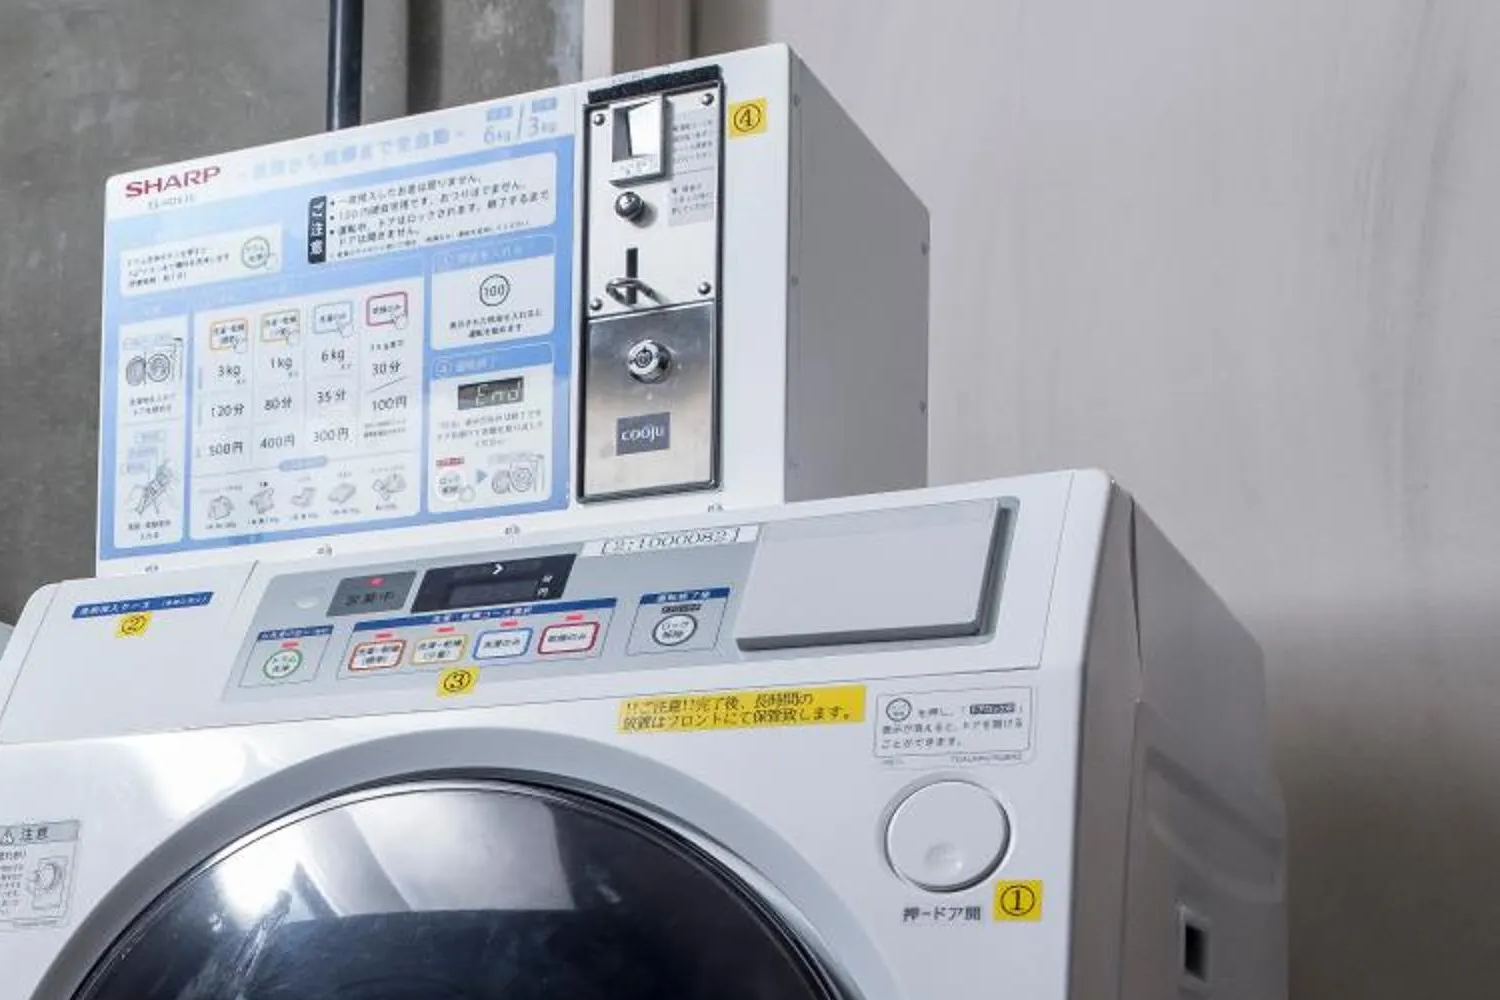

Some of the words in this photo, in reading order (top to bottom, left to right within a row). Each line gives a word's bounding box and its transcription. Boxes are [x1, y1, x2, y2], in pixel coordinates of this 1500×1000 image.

[125, 166, 221, 198] SHARP
[372, 361, 401, 376] 30分
[372, 395, 407, 412] 100円
[260, 434, 295, 449] 400円
[313, 427, 349, 443] 300円
